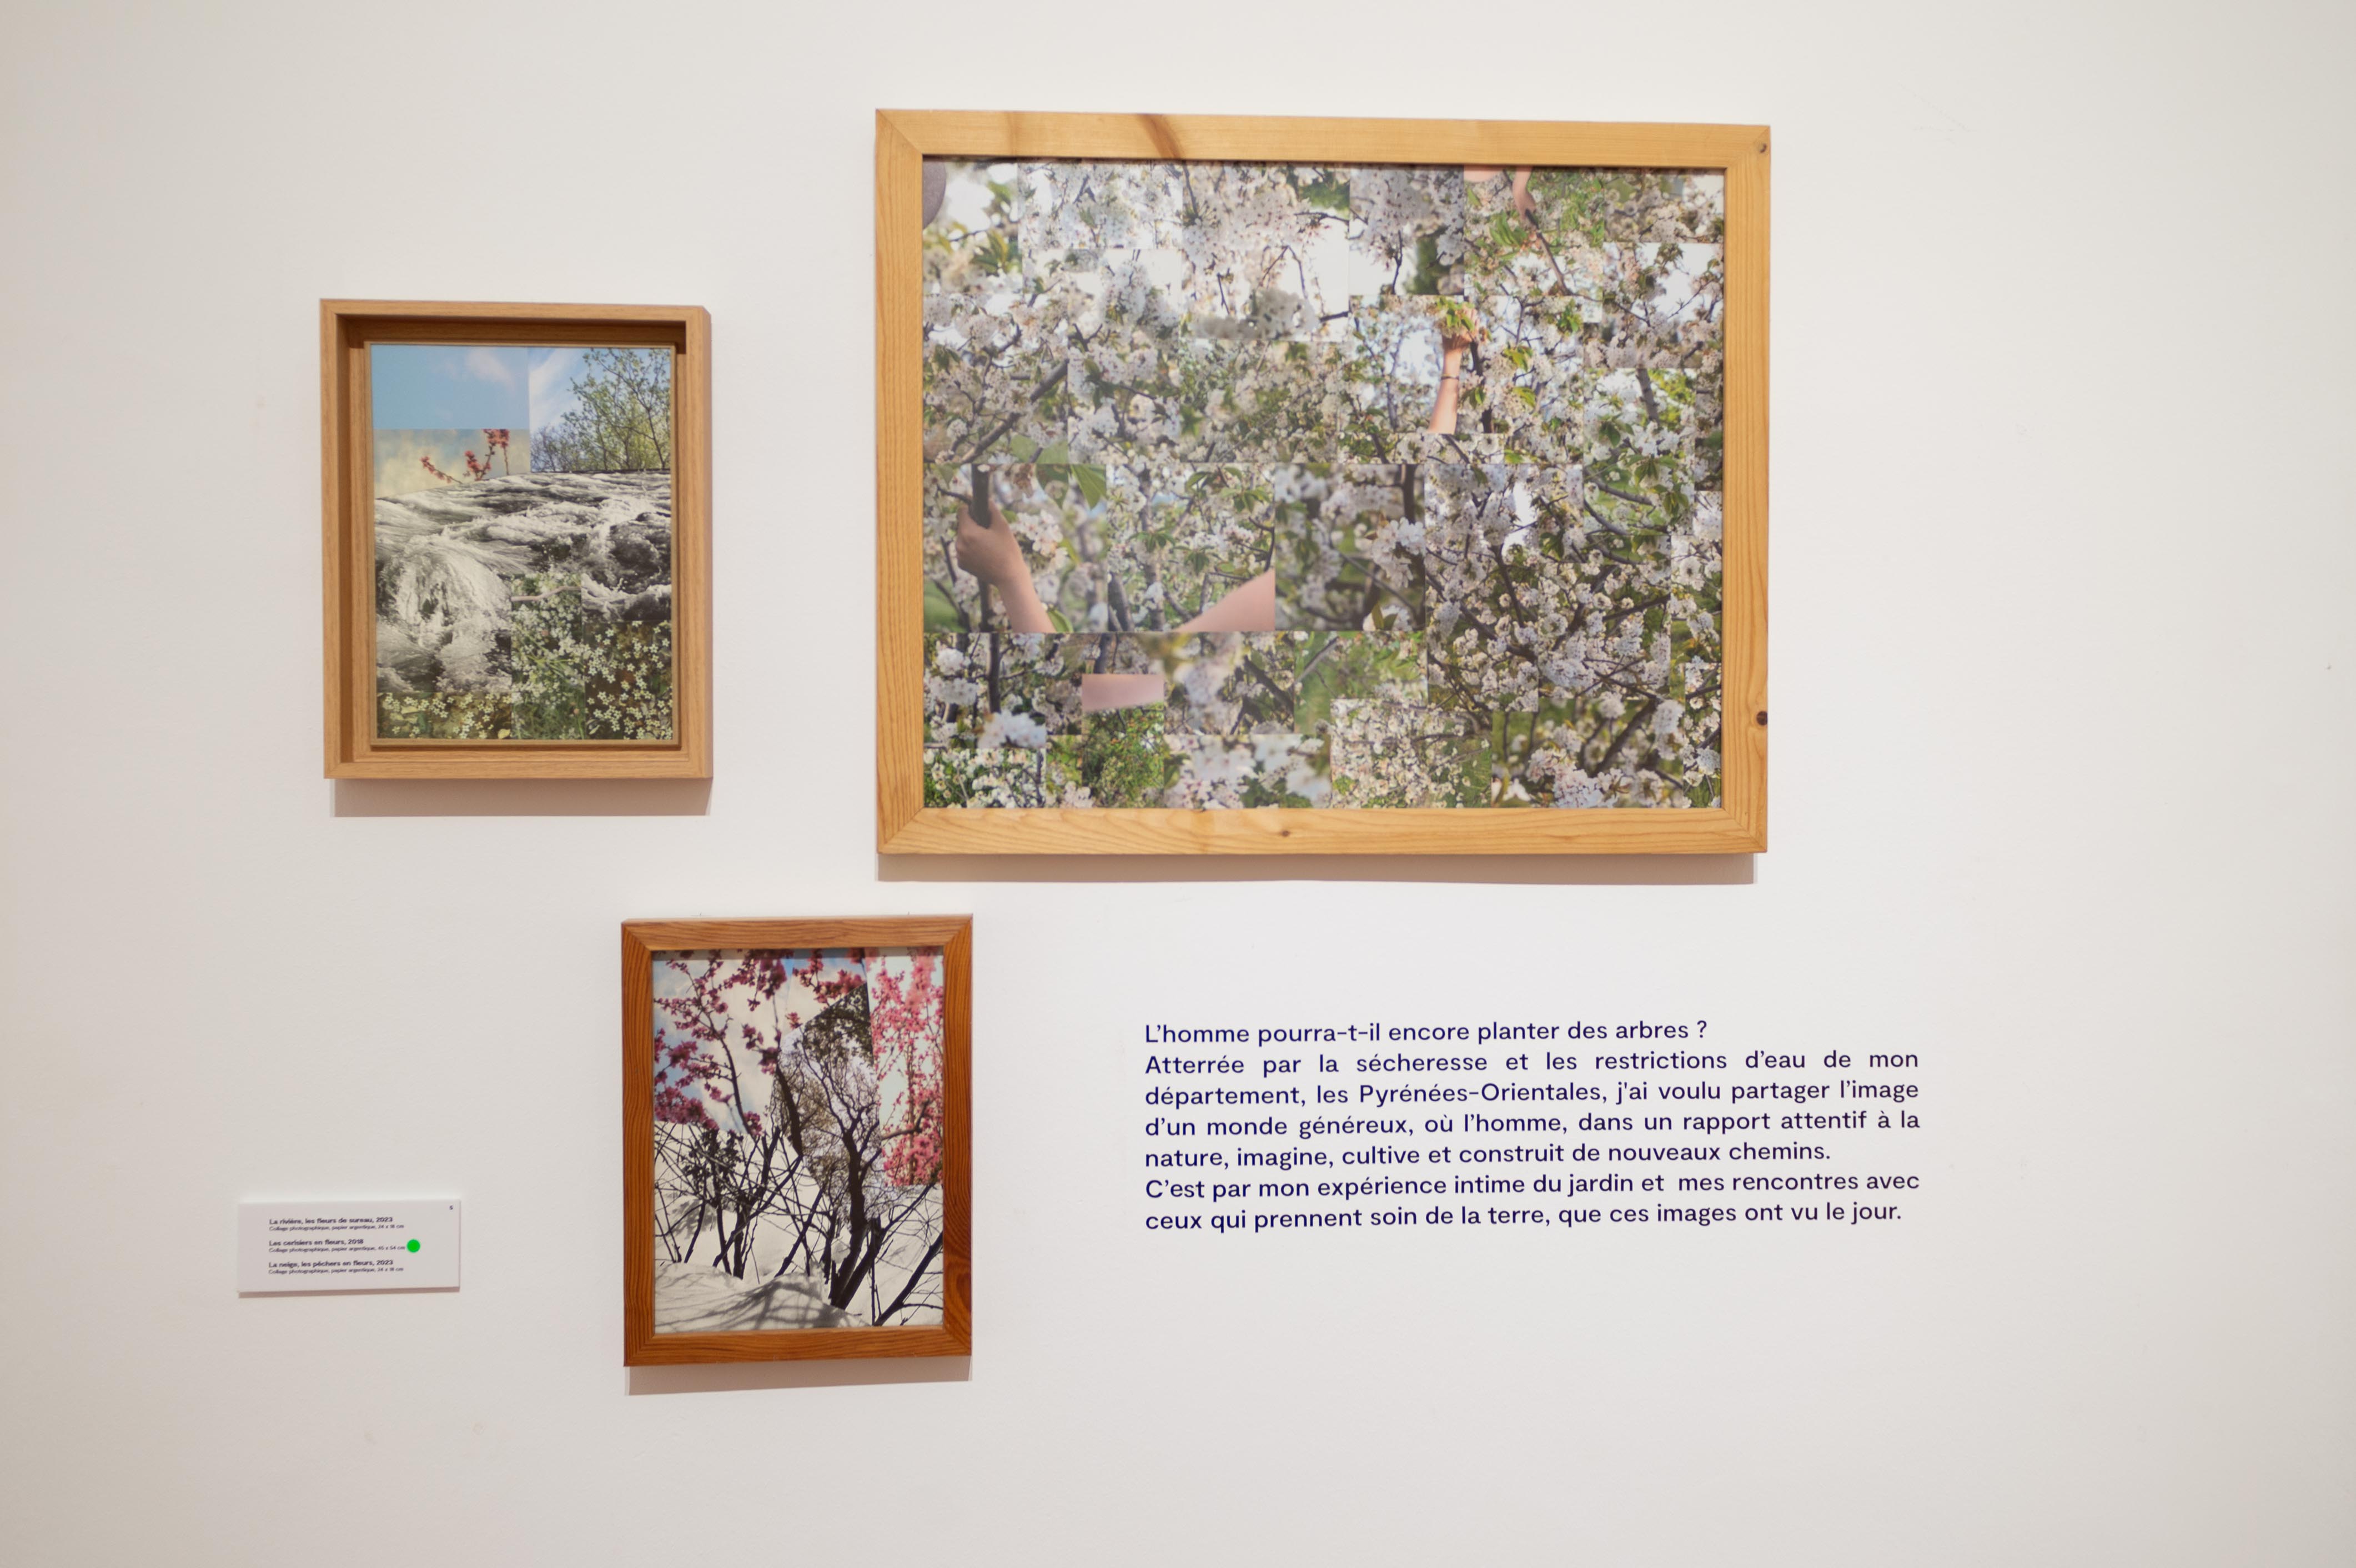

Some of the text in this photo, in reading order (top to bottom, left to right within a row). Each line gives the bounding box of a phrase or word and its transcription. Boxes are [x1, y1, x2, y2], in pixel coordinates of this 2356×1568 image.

[1146, 1020, 1707, 1047] L’homme pourra-t-il encore planter des arbres ?
[1145, 1049, 1918, 1078] Atterrée par la sécheresse et les restrictions d’eau de mon
[1145, 1079, 1918, 1110] département, les Pyrénées-Orientales, j'ai voulu partager l’image
[1145, 1110, 1921, 1140] d’un monde généreux, où l’homme, dans un rapport attentif à la
[1146, 1141, 1830, 1171] nature, imagine, cultive et construit de nouveaux chemins.
[1146, 1173, 1920, 1203] C’est par mon expérience intime du jardin et mes rencontres avec
[1146, 1201, 1901, 1234] ceux qui prennent soin de la terre, que ces images ont vu le jour.
